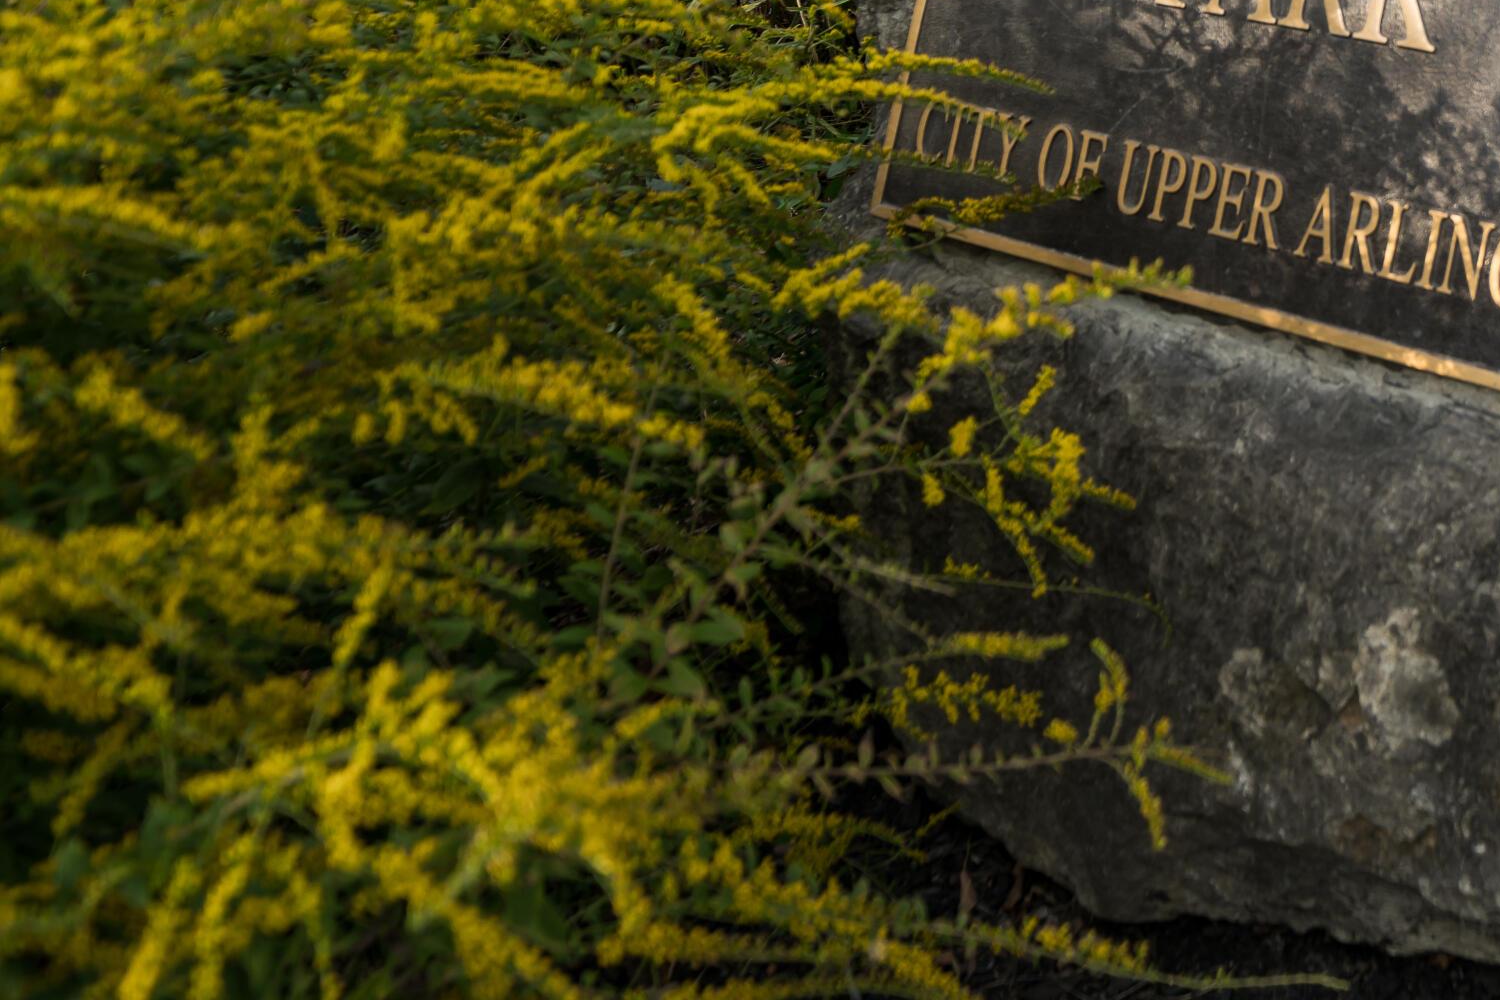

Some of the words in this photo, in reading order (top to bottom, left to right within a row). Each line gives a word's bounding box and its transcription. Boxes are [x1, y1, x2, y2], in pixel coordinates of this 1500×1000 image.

[917, 101, 1033, 180] CITY
[1038, 123, 1108, 200] OF
[1117, 140, 1285, 251] UPPER
